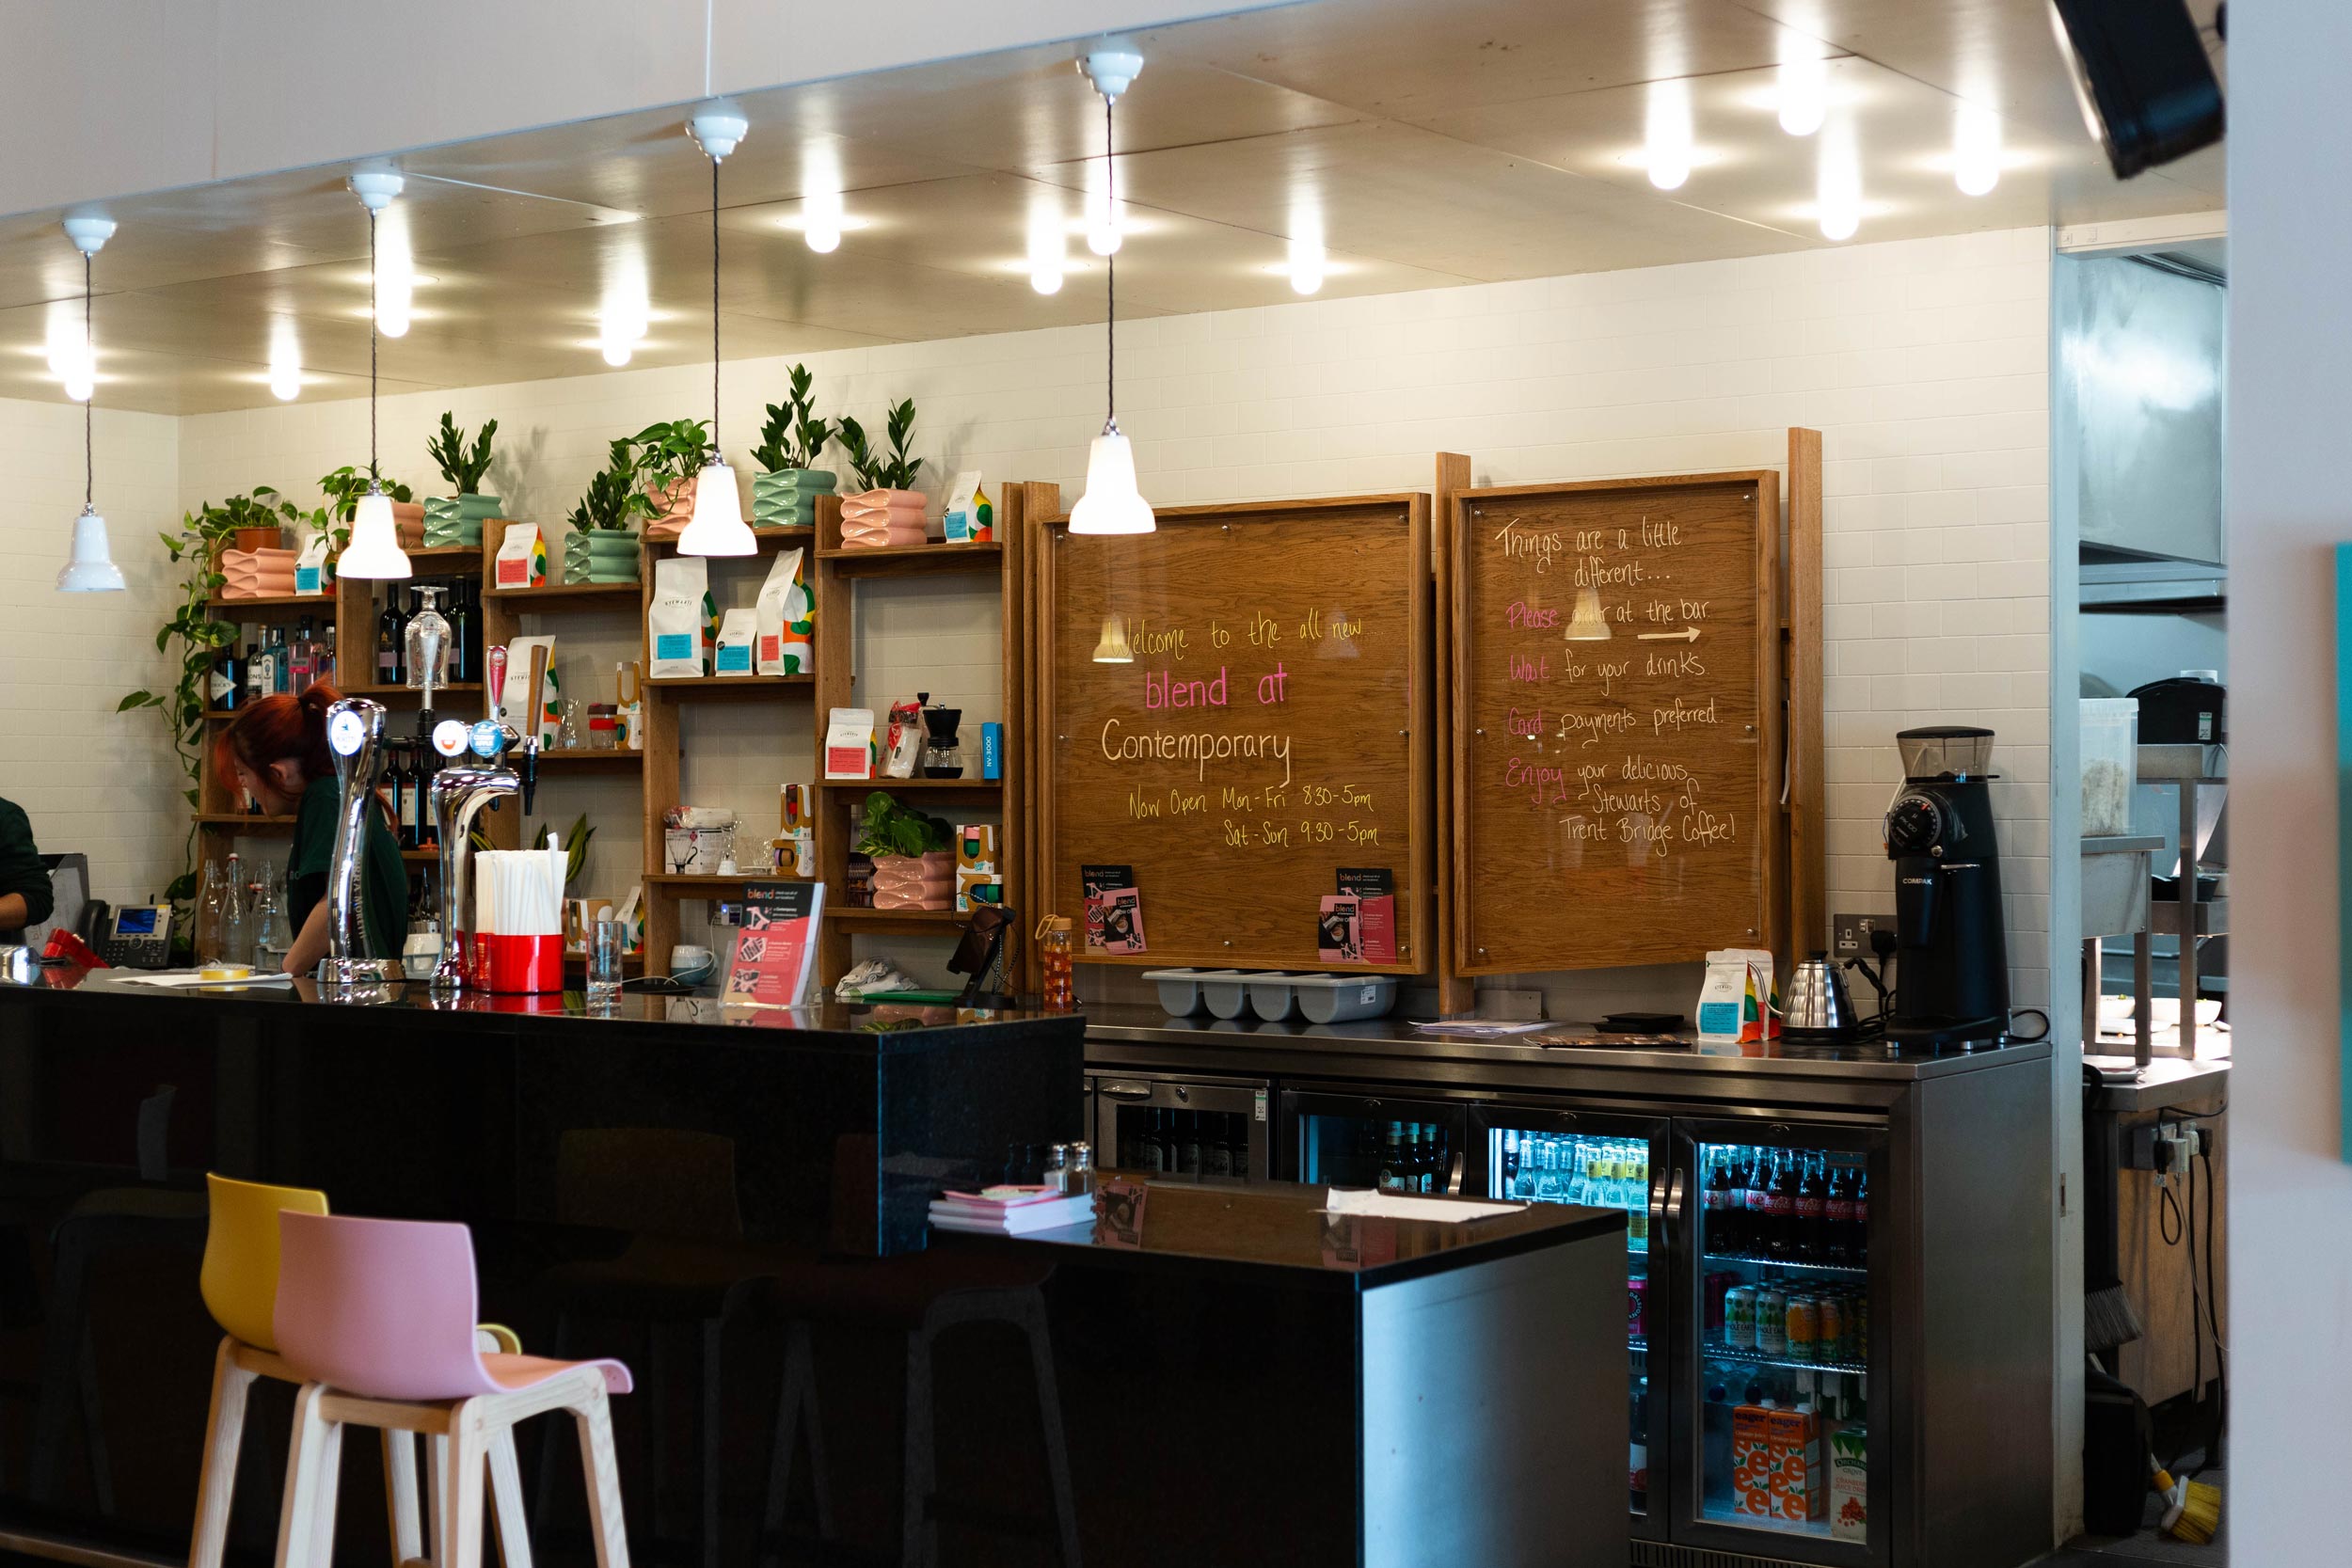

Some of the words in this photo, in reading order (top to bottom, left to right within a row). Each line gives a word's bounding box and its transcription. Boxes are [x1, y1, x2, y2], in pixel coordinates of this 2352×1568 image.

[1495, 517, 1562, 574] Things
[1577, 531, 1603, 551] are
[1618, 529, 1629, 549] a
[1642, 516, 1681, 547] little
[1506, 601, 1560, 628] Please
[1616, 600, 1633, 623] at
[1646, 599, 1674, 625] the
[1109, 617, 1189, 660] Welcome
[1212, 621, 1230, 648] to
[1248, 610, 1280, 648] the
[1300, 608, 1322, 640] all
[1146, 666, 1227, 708] blend
[1258, 662, 1287, 704] at
[1510, 655, 1549, 682] Wait
[1565, 649, 1586, 682] for
[1597, 660, 1629, 696] your
[1508, 707, 1543, 736] Card
[1561, 708, 1636, 749] payments
[1102, 719, 1290, 788] Contemporary
[1505, 758, 1566, 804] Enjoy
[1578, 764, 1609, 800] your
[1623, 754, 1688, 781] delicious
[1593, 784, 1661, 814] Stewarts
[1679, 777, 1700, 816] of
[1129, 784, 1160, 819] Now
[1170, 789, 1207, 815] Open
[1559, 815, 1607, 841] Trent
[1616, 817, 1674, 857] Bridge
[1085, 869, 1104, 878] blend
[1340, 873, 1361, 881] blend
[1902, 878, 1932, 886] COMPAK
[747, 888, 774, 899] blend
[1117, 896, 1136, 905] blend
[1336, 903, 1355, 912] blend
[1736, 1412, 1766, 1423] eager
[1771, 1418, 1802, 1428] eager
